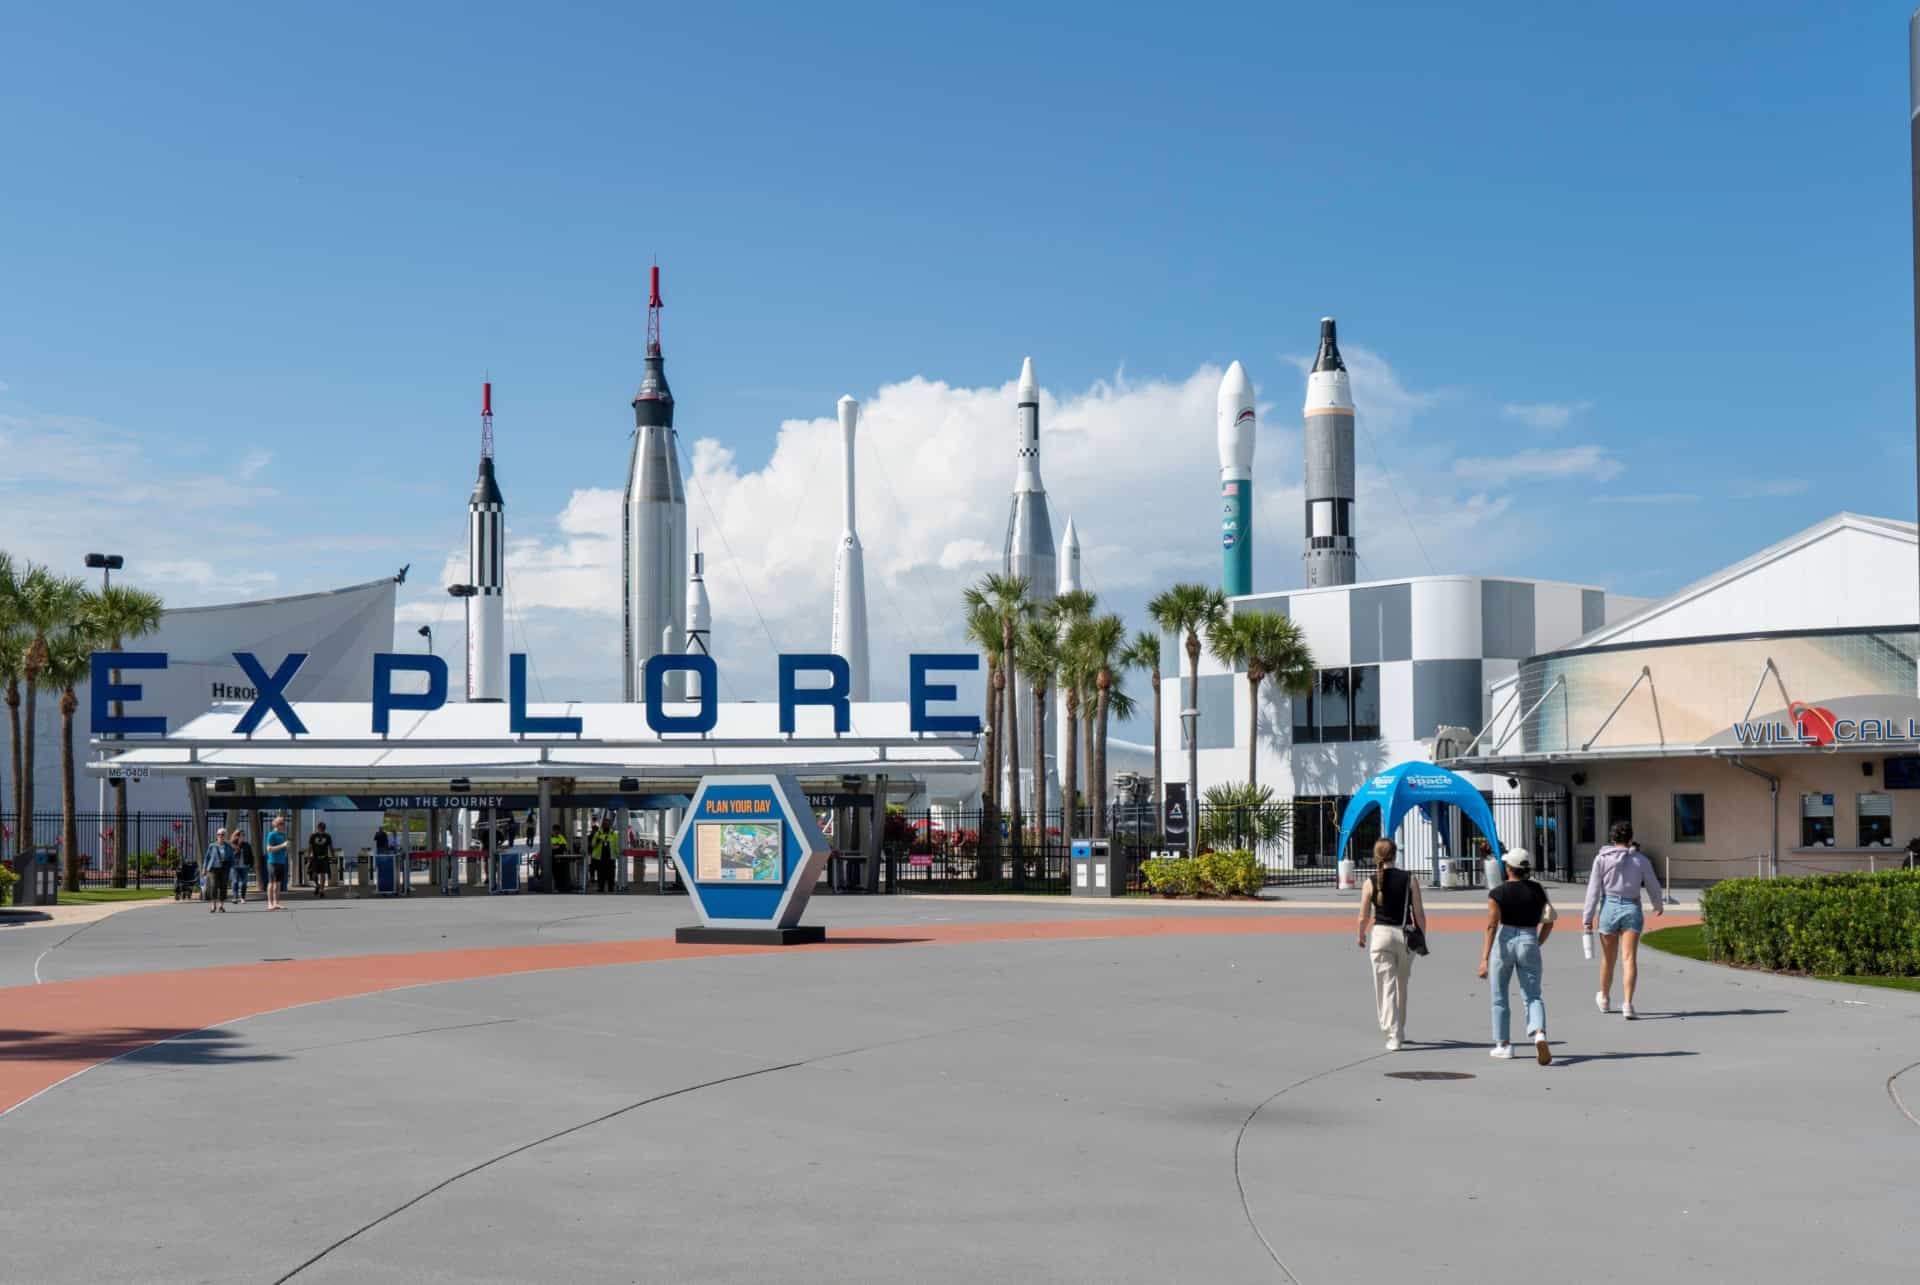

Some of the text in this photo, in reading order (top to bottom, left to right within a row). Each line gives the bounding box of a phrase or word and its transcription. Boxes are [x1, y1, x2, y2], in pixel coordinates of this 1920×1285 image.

[90, 653, 981, 734] EXPLORE
[1733, 717, 1920, 743] WILL CALL
[378, 796, 503, 808] JOIN THE JOURNEY
[706, 799, 771, 814] PLAN YOUR DAY
